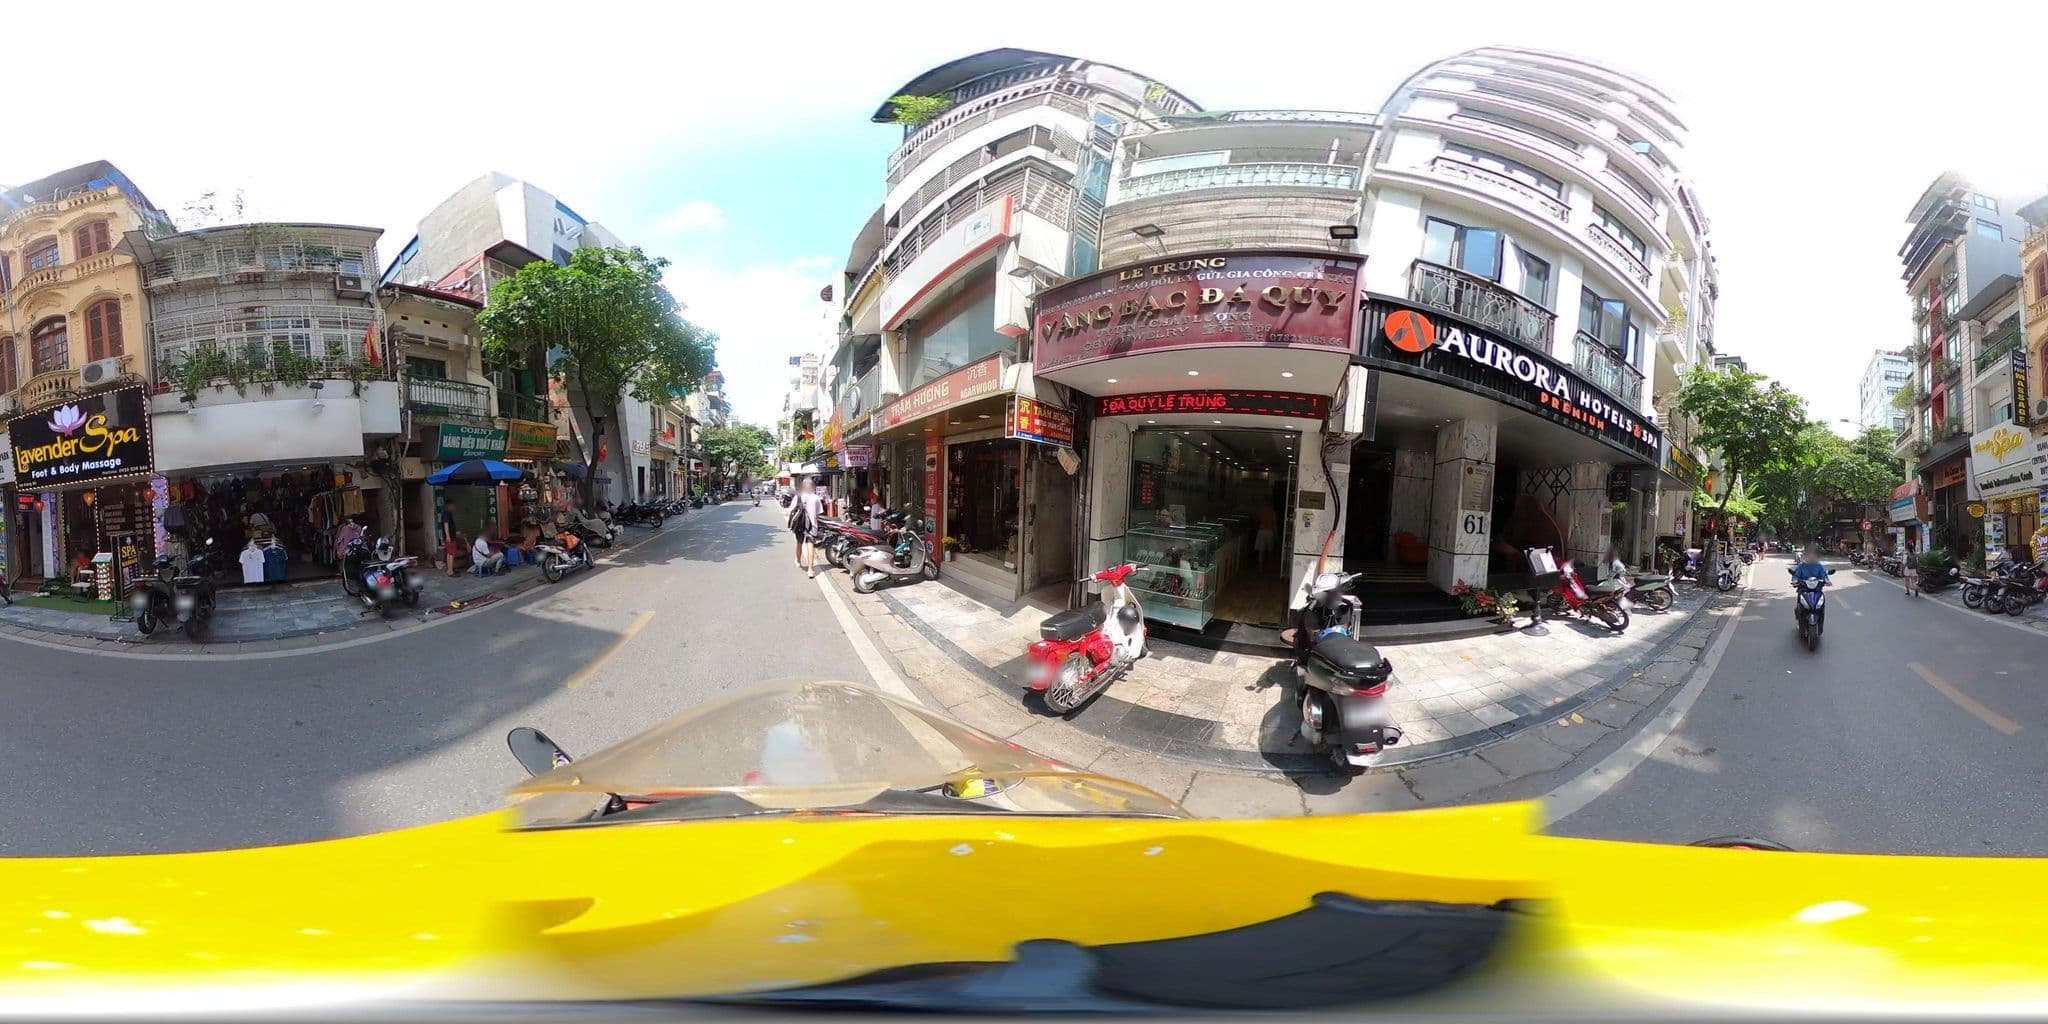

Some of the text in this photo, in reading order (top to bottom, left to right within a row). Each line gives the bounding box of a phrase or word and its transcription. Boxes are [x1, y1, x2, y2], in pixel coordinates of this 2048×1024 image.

[1150, 257, 1226, 275] TRUNG
[1226, 270, 1250, 279] GIA
[967, 361, 988, 381] 沉香
[960, 379, 997, 399] AGARWOOD
[1438, 327, 1659, 450] AURORA HOTELS & SPA
[2015, 372, 2026, 424] MASSAGE
[1178, 395, 1227, 408] TRUNG
[1540, 391, 1606, 432] PREMIUM
[460, 426, 495, 435] CORNY
[15, 414, 140, 473] Lavender Spa
[463, 449, 485, 457] EXPORT
[31, 470, 48, 479] Foot
[51, 467, 57, 475] &
[60, 464, 80, 475] Body
[82, 457, 121, 471] Massage
[1464, 514, 1485, 535] 61
[121, 545, 137, 558] SPA
